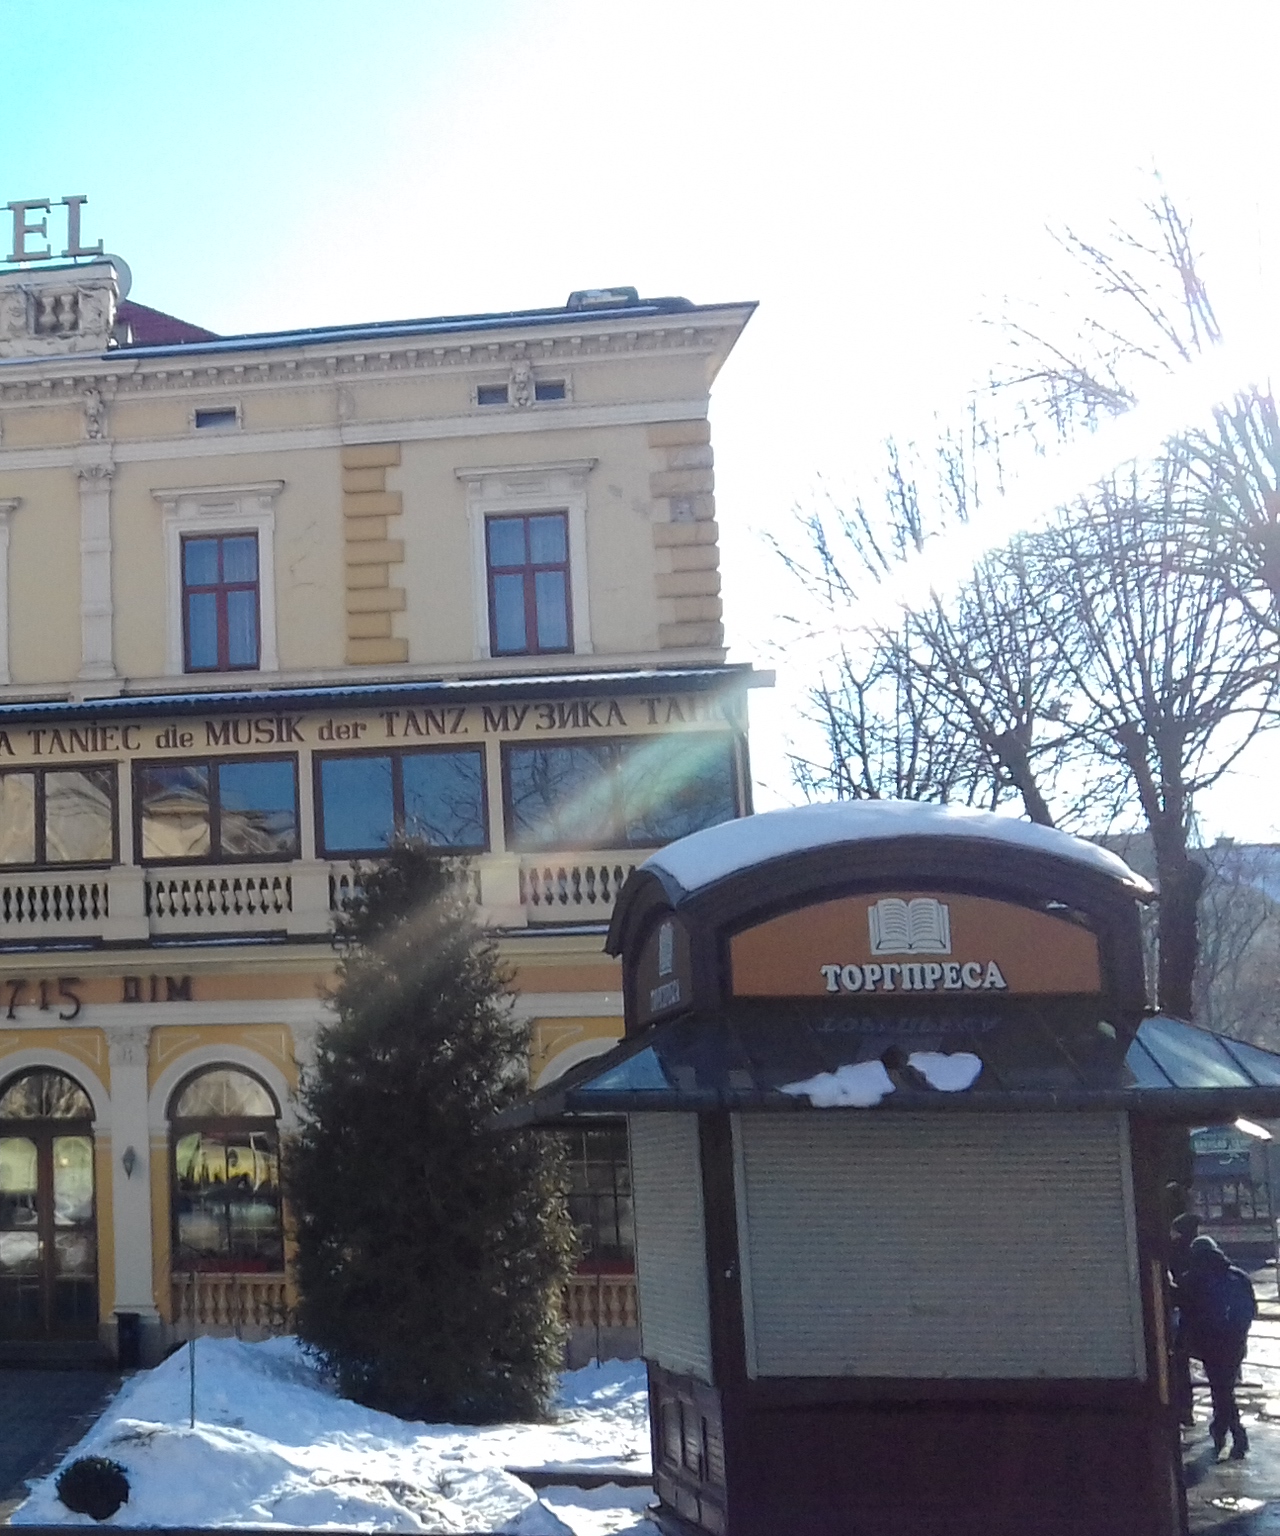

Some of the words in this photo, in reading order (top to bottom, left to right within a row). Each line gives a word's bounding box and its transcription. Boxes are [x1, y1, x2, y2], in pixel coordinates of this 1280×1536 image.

[30, 724, 142, 755] TANIEC
[155, 723, 194, 749] die
[204, 714, 305, 746] MUSIK
[317, 717, 367, 741] der
[378, 707, 470, 737] TANZ
[481, 699, 628, 732] МУЗИКА
[123, 974, 193, 1003] ДІМ
[820, 960, 1009, 993] ТОРГПРЕСА
